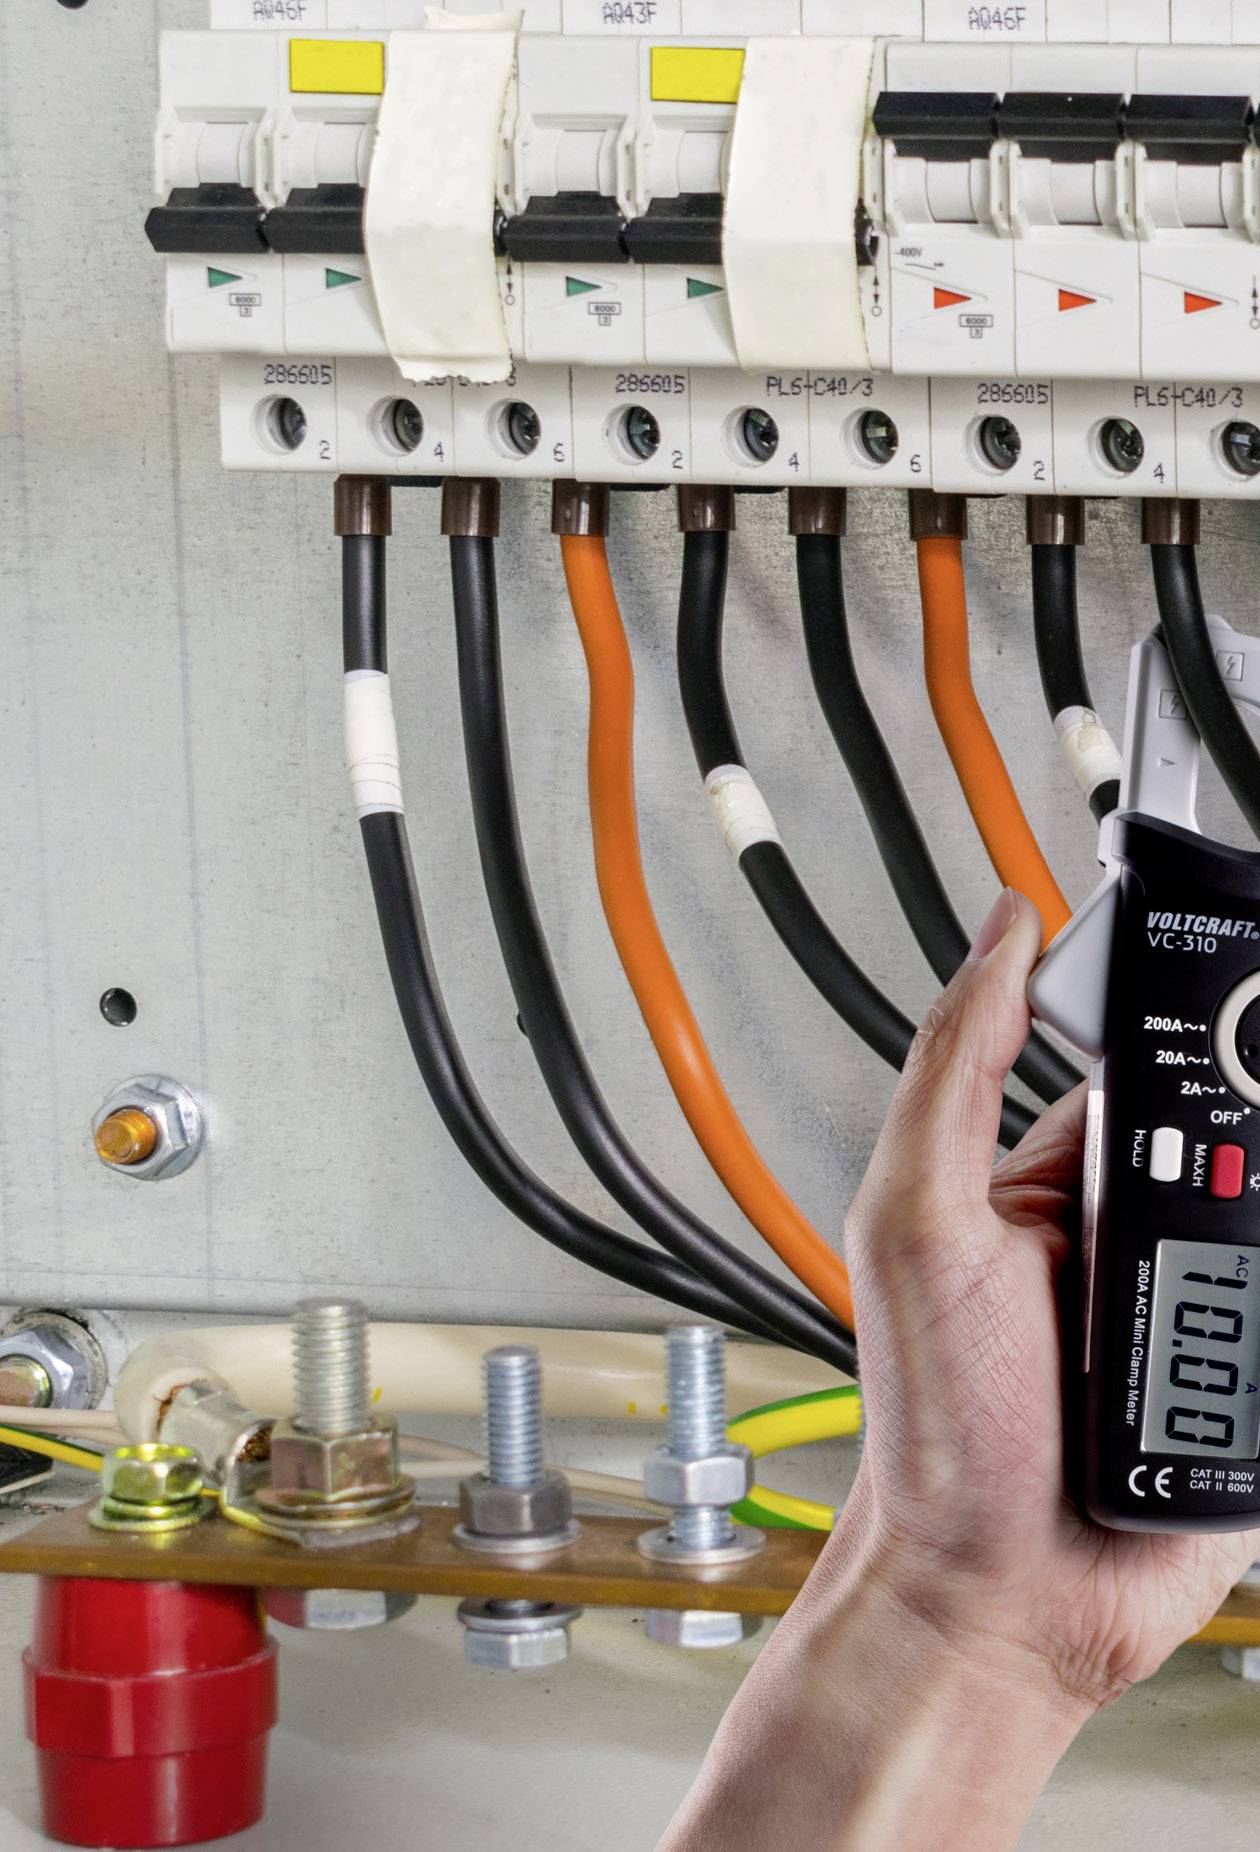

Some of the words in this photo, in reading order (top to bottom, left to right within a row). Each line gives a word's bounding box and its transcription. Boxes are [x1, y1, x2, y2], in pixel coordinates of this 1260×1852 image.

[603, 2, 657, 24] AQ43F
[968, 7, 1026, 31] AQ46F
[264, 364, 332, 385] 286605
[616, 374, 685, 394] 286605
[977, 383, 1049, 404] 286605
[319, 440, 330, 460] 2
[433, 441, 445, 462] 4
[554, 443, 565, 462] 6
[672, 450, 683, 469] 2
[787, 452, 800, 472] 4
[910, 454, 922, 472] 6
[1034, 461, 1045, 481] 2
[1153, 463, 1165, 484] 4
[1147, 931, 1217, 953] VC-310
[1210, 1110, 1242, 1125] OFF
[1132, 1129, 1147, 1167] HOLD
[1192, 1144, 1207, 1187] MAXH
[1137, 1260, 1150, 1293] 200A
[1236, 1254, 1249, 1278] AC
[1135, 1295, 1148, 1315] AC
[1133, 1318, 1146, 1344] Mini
[1127, 1347, 1144, 1387] Clamp
[1165, 1271, 1248, 1448] 10.00
[1245, 1382, 1258, 1394] A
[1126, 1390, 1140, 1426] Meter
[1128, 1465, 1173, 1499] CE
[1190, 1468, 1212, 1479] CAT
[1215, 1470, 1225, 1480] III
[1228, 1471, 1255, 1482] 300V
[1189, 1480, 1211, 1490] CAT
[1216, 1482, 1222, 1491] II
[1227, 1483, 1254, 1493] 600V
